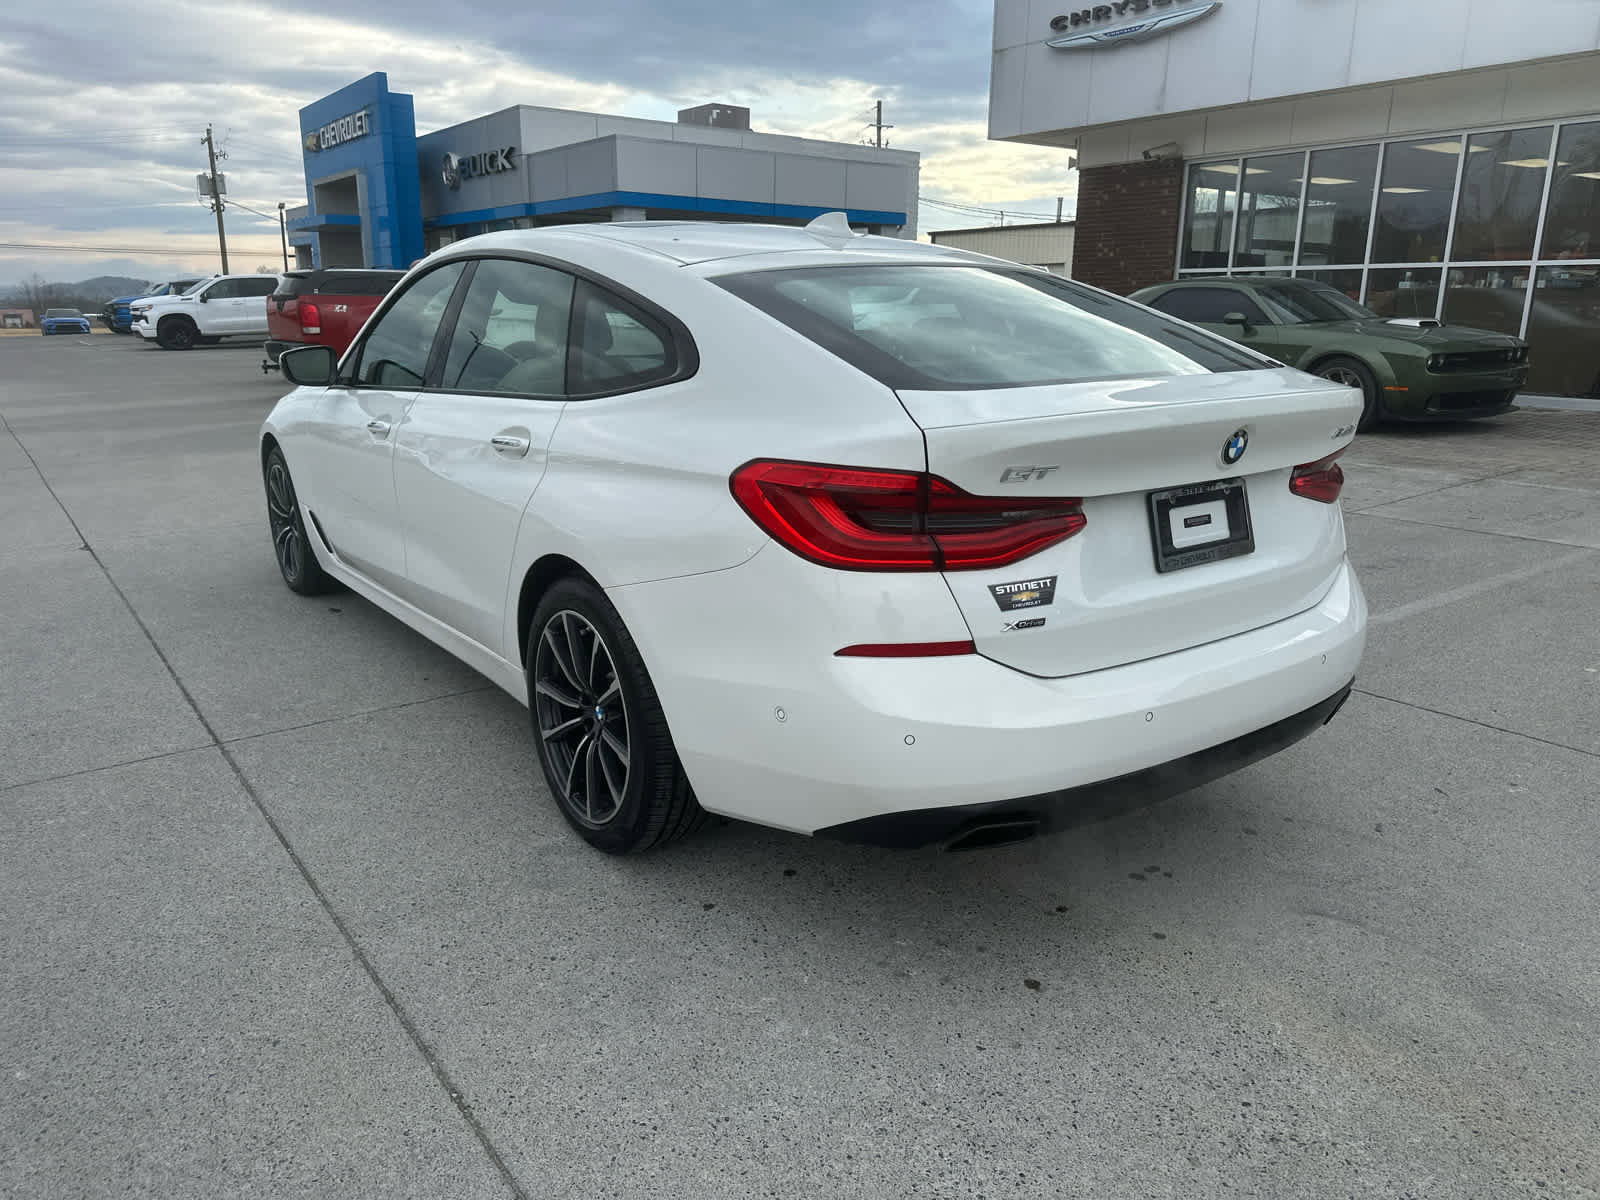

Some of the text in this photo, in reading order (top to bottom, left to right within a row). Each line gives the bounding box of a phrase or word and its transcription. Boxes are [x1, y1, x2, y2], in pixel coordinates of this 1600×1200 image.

[319, 110, 369, 149] CHEVROLET
[458, 147, 514, 180] BUICK
[1000, 465, 1060, 483] GT
[995, 578, 1052, 595] STINNETT
